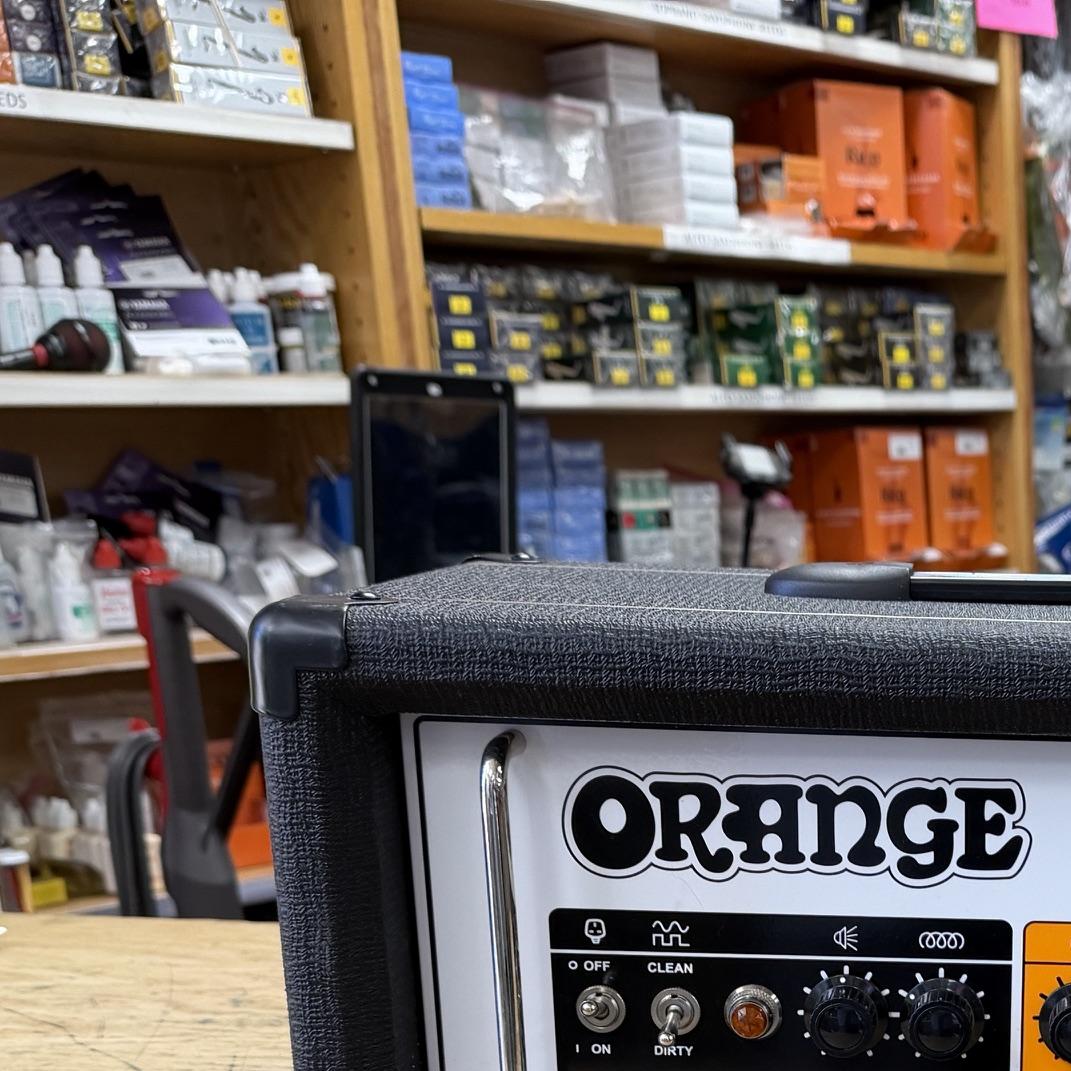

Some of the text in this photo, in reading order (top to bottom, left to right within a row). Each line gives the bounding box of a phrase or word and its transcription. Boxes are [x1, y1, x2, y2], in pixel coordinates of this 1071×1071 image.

[571, 773, 1025, 880] ORANGE
[583, 960, 611, 972] OFF
[647, 961, 694, 974] CLEAN
[591, 1043, 612, 1055] ON
[654, 1045, 694, 1057] DIRTY
